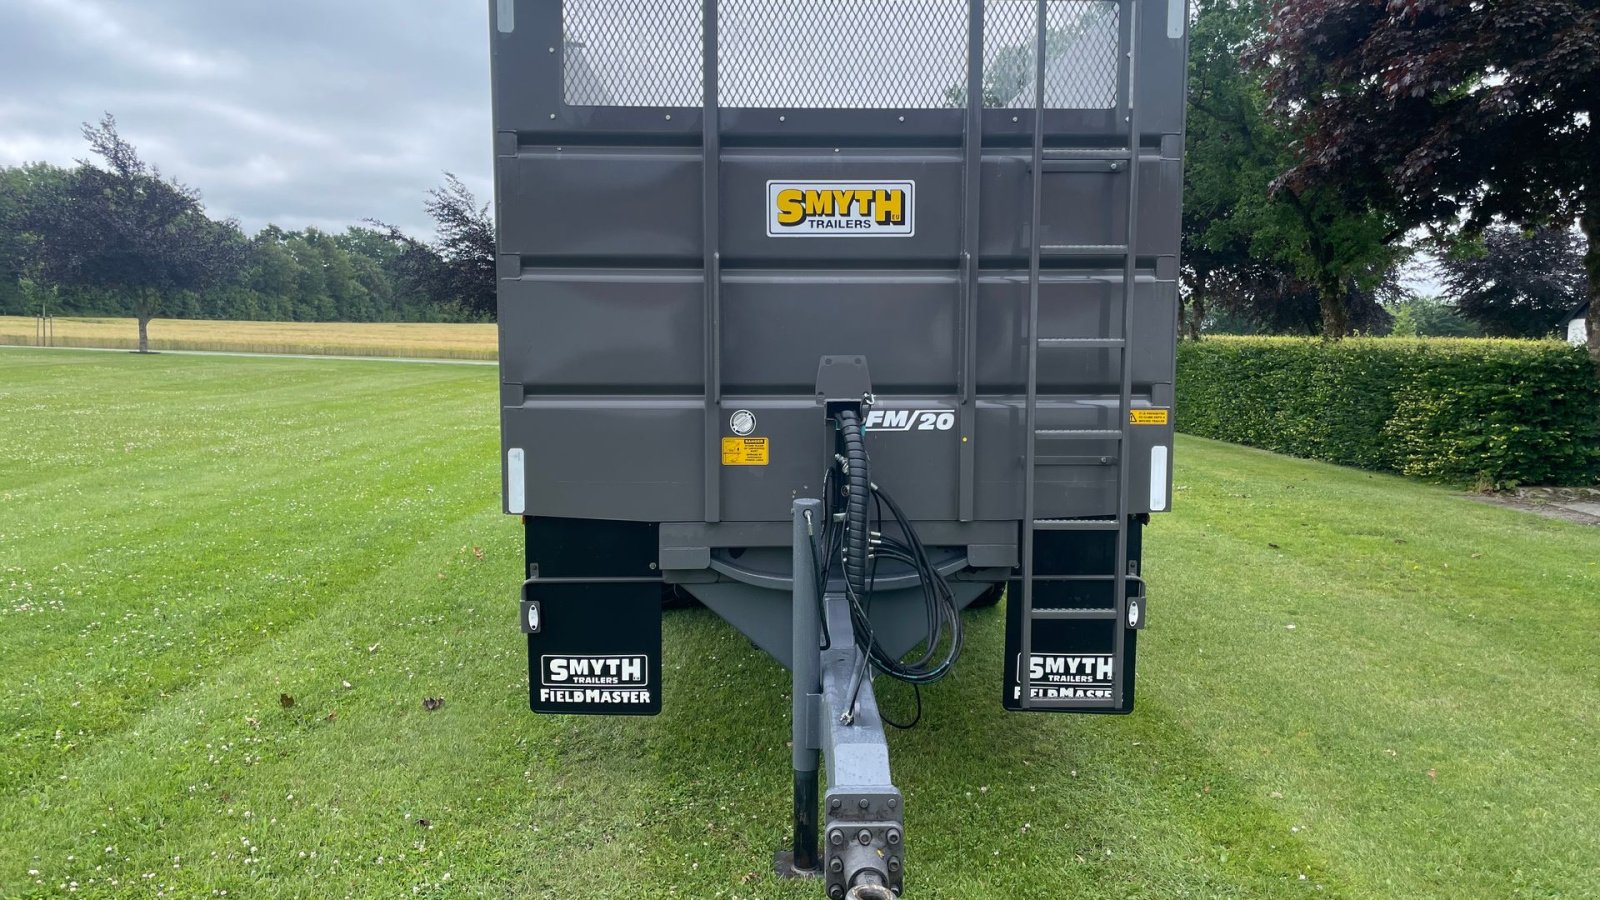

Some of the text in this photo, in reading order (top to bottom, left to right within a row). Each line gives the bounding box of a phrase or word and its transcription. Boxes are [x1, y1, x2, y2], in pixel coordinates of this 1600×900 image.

[776, 189, 905, 226] SMYTH
[808, 219, 871, 229] TRAILERS
[865, 409, 955, 431] FM/20
[549, 658, 641, 682] SMYTH
[1029, 656, 1113, 680] SMYTH
[573, 676, 618, 684] TRAILERS
[1048, 674, 1094, 683] TRAILERS
[540, 688, 651, 704] FIELDMASTER
